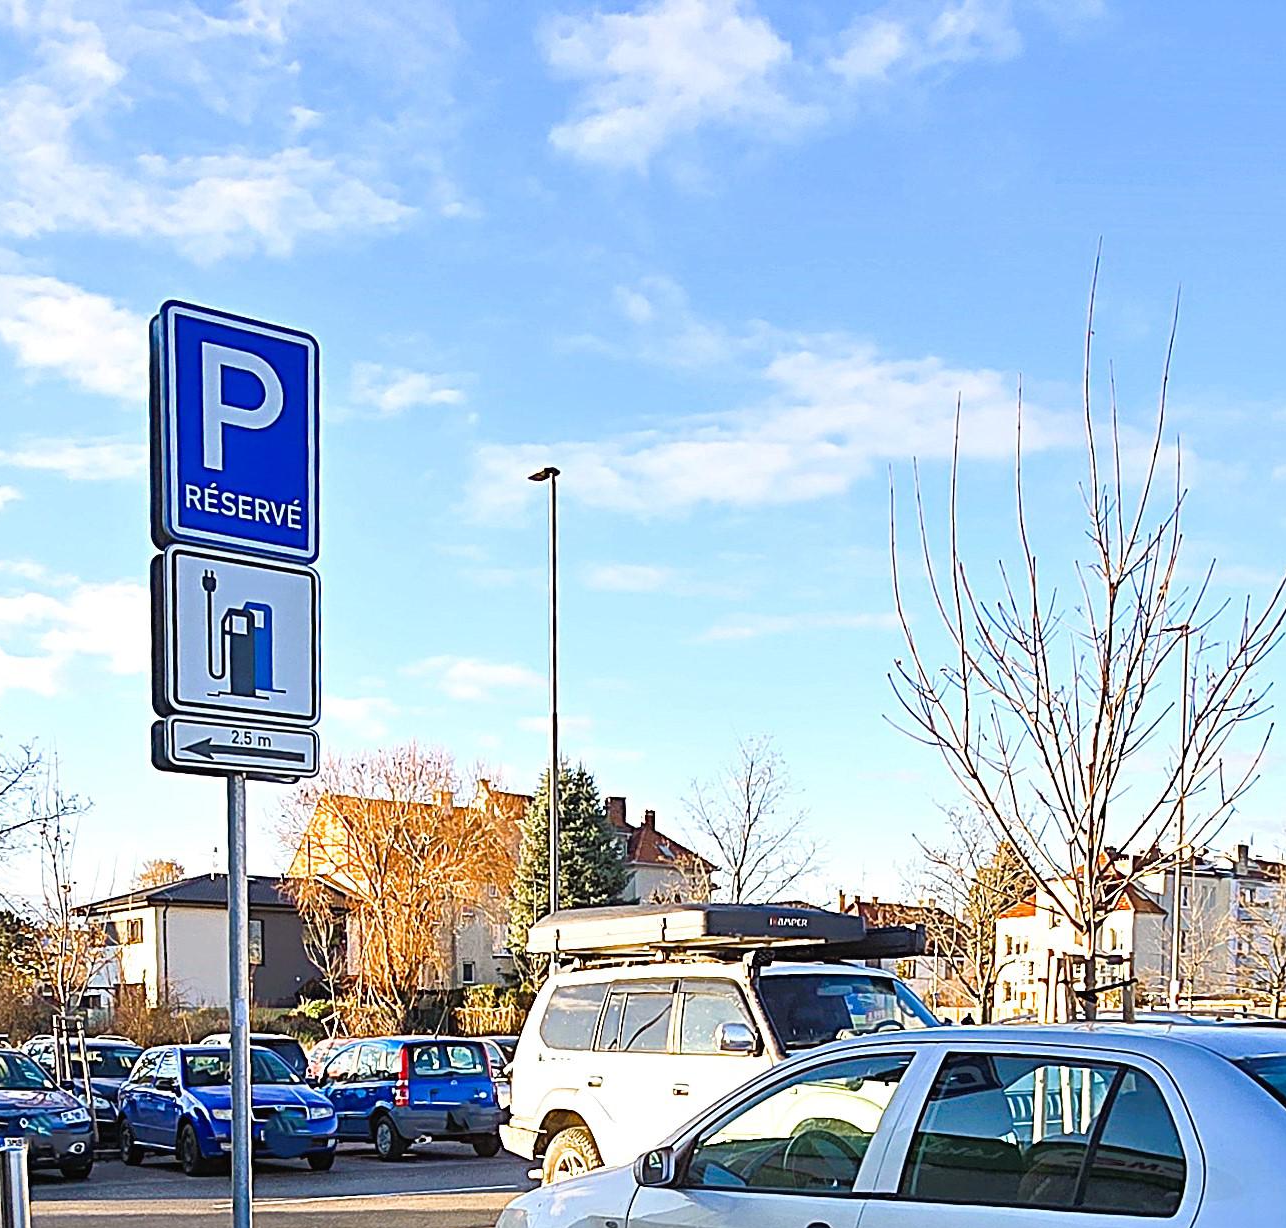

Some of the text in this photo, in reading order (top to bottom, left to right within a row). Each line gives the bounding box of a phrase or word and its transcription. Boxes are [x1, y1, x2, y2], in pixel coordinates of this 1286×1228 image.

[201, 341, 284, 471] P
[185, 483, 302, 530] RÉSERVÉ
[257, 736, 272, 748] m
